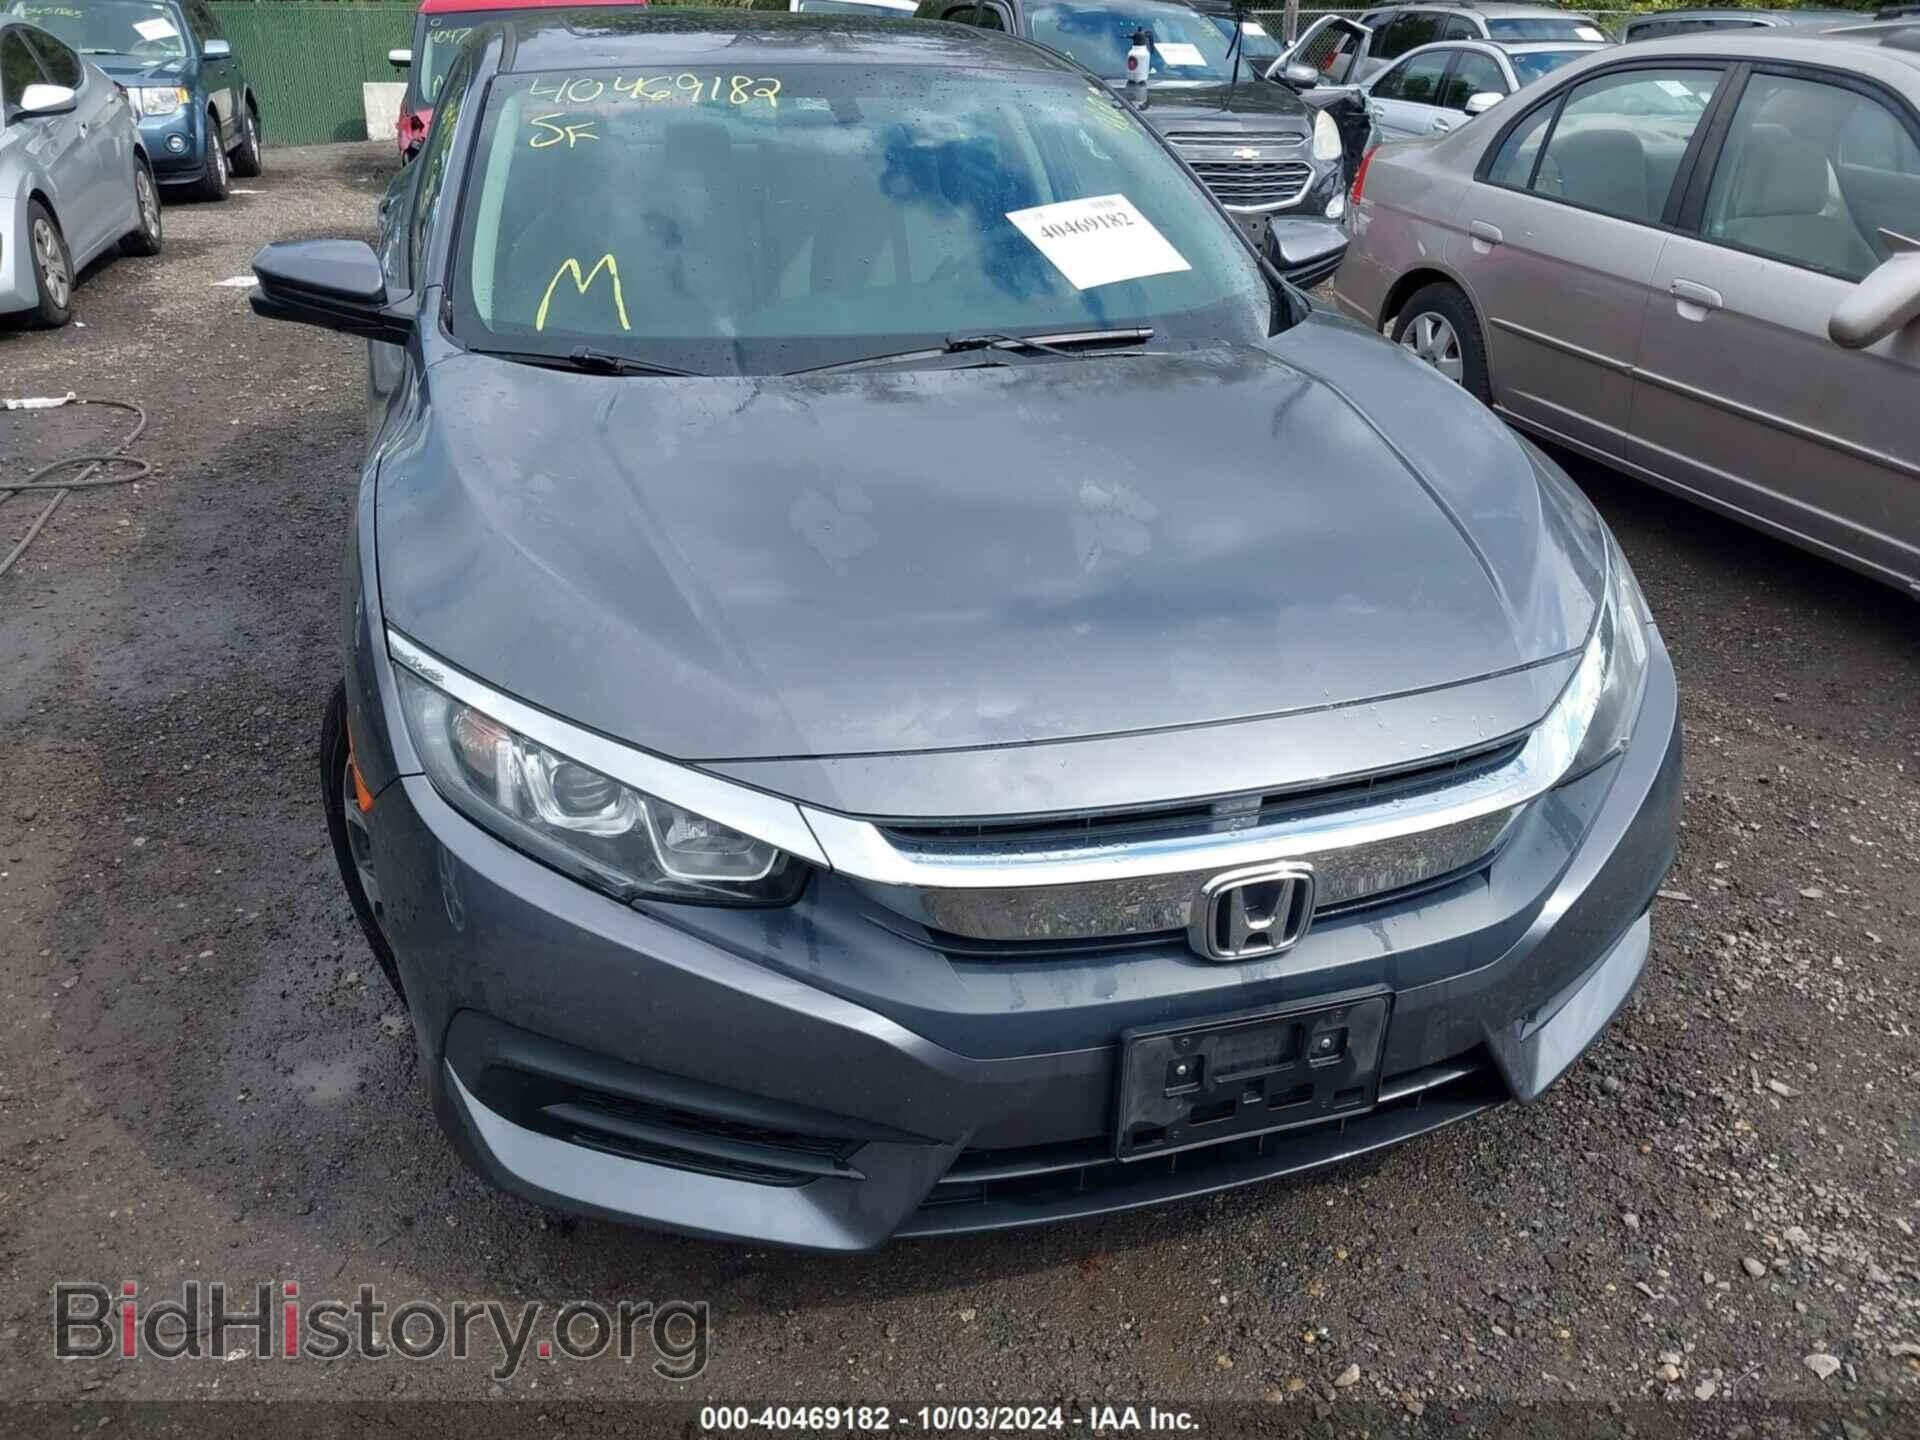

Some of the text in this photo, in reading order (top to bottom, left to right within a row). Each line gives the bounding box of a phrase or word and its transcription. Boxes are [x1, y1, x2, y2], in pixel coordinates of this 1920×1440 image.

[529, 73, 781, 107] 40469182
[1041, 211, 1135, 239] 40469182
[536, 254, 632, 331] M
